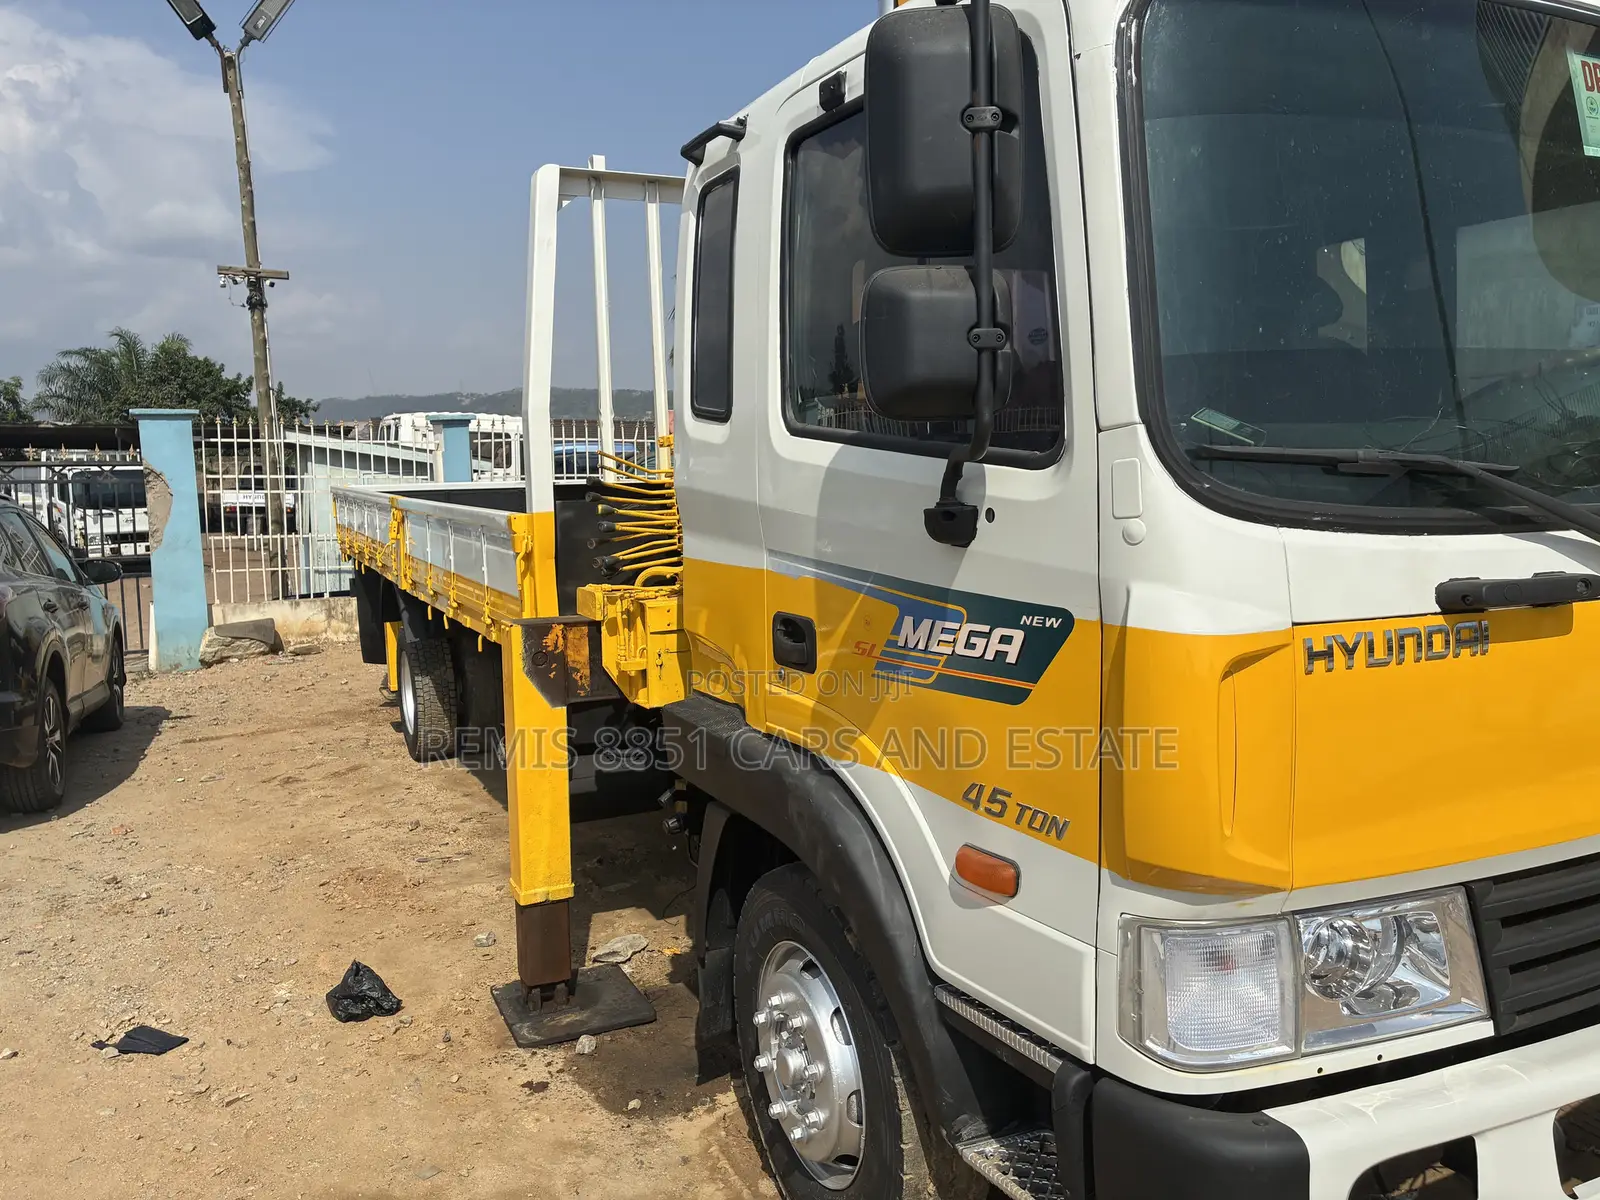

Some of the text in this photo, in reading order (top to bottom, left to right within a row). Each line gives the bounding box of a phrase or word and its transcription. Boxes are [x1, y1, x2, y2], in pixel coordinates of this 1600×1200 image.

[898, 615, 1025, 666] MEGA
[1020, 615, 1063, 629] NEW
[1303, 620, 1489, 675] HYUNDAI
[1014, 801, 1071, 841] TON
